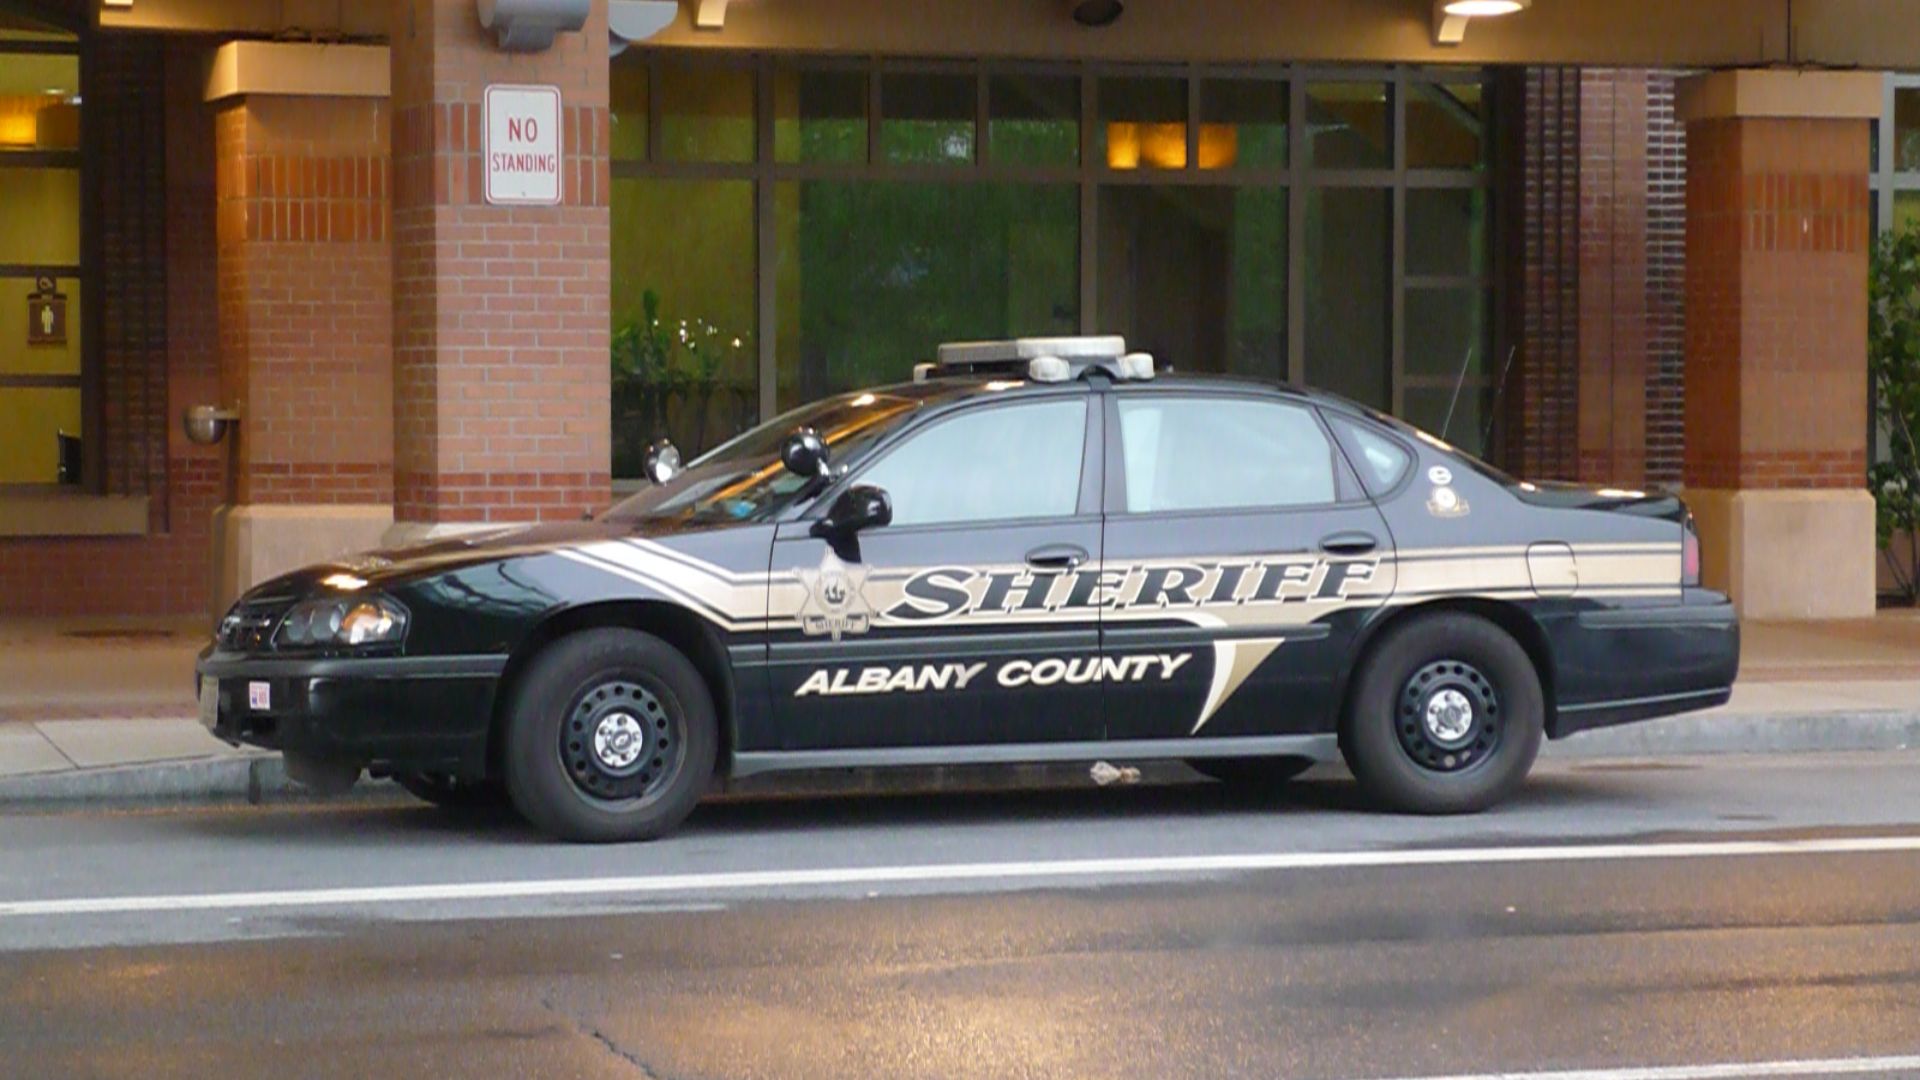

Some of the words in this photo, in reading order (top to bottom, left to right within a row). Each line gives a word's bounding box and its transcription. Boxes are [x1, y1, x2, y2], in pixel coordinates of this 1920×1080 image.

[508, 117, 538, 142] NO
[492, 153, 555, 173] STANDING
[882, 557, 1380, 623] SHERIFF
[794, 662, 987, 697] ALBANY
[997, 653, 1192, 687] COUNTY
